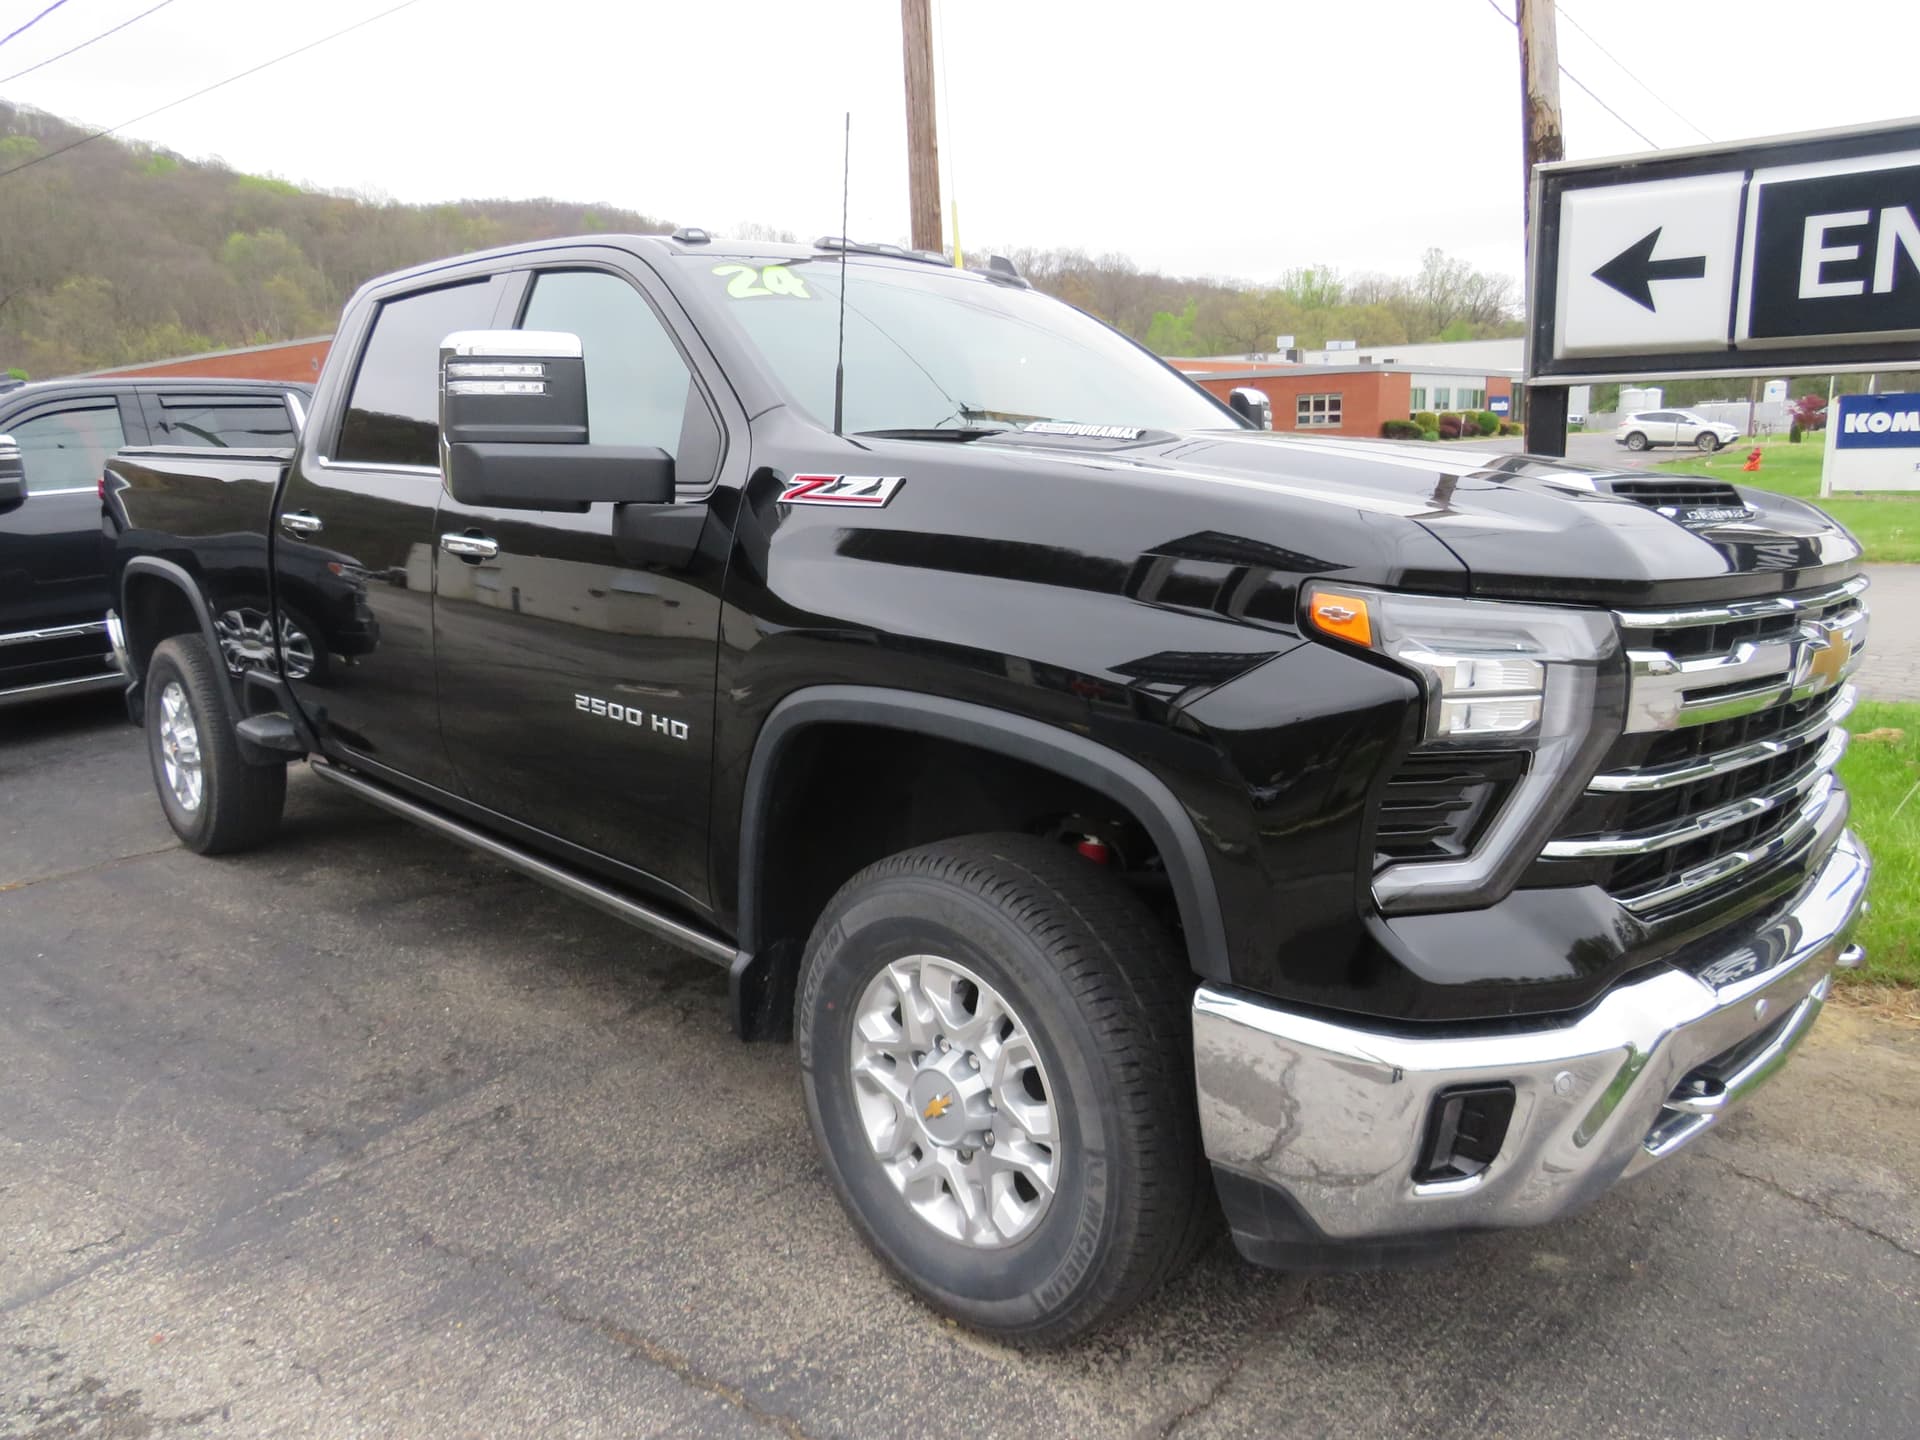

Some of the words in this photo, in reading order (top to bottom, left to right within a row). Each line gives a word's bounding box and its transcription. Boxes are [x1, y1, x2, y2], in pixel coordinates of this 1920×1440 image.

[711, 264, 811, 299] 24
[1068, 423, 1142, 440] DURAMAX
[777, 474, 904, 508] Z71
[574, 693, 643, 727] 2500
[651, 713, 689, 741] HD
[1038, 1196, 1106, 1313] MICHELIN
